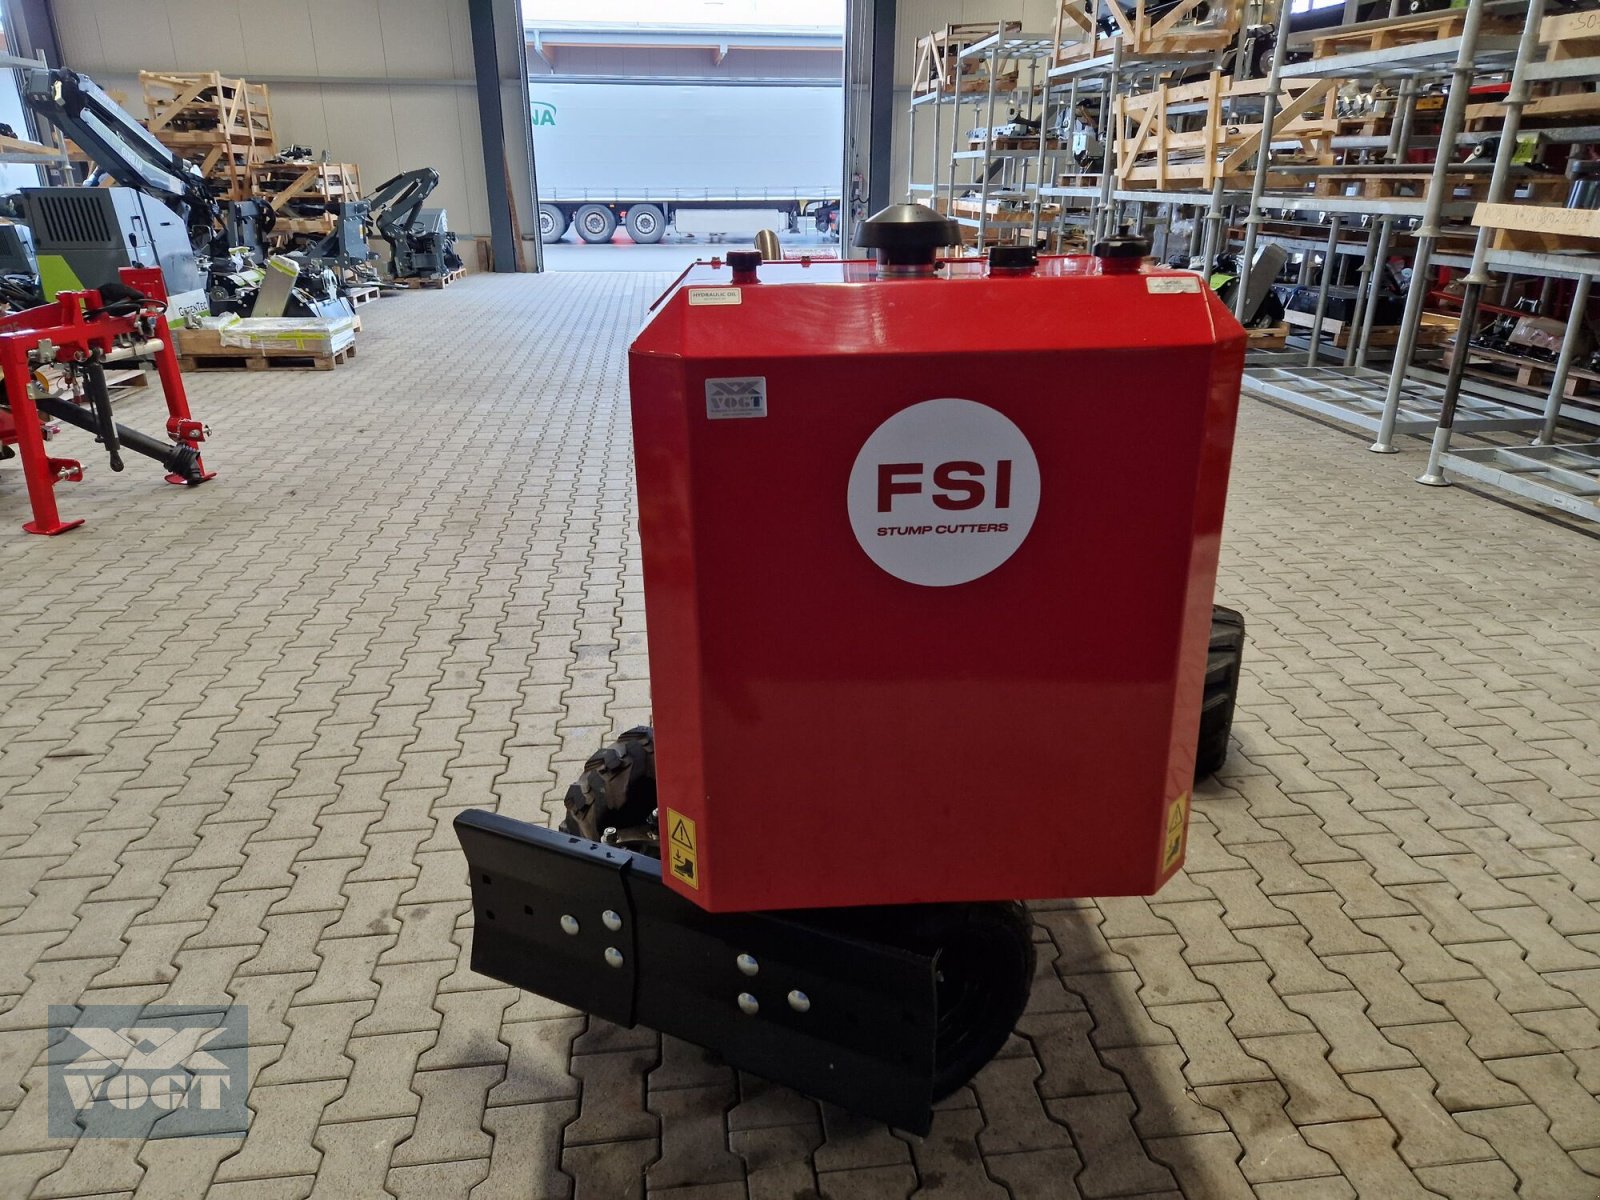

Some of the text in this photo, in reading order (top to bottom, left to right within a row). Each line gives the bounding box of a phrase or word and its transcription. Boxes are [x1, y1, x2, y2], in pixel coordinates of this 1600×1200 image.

[710, 396, 763, 409] VOGT
[877, 460, 1012, 513] FSI
[877, 523, 1009, 537] STUMP CUTTERS
